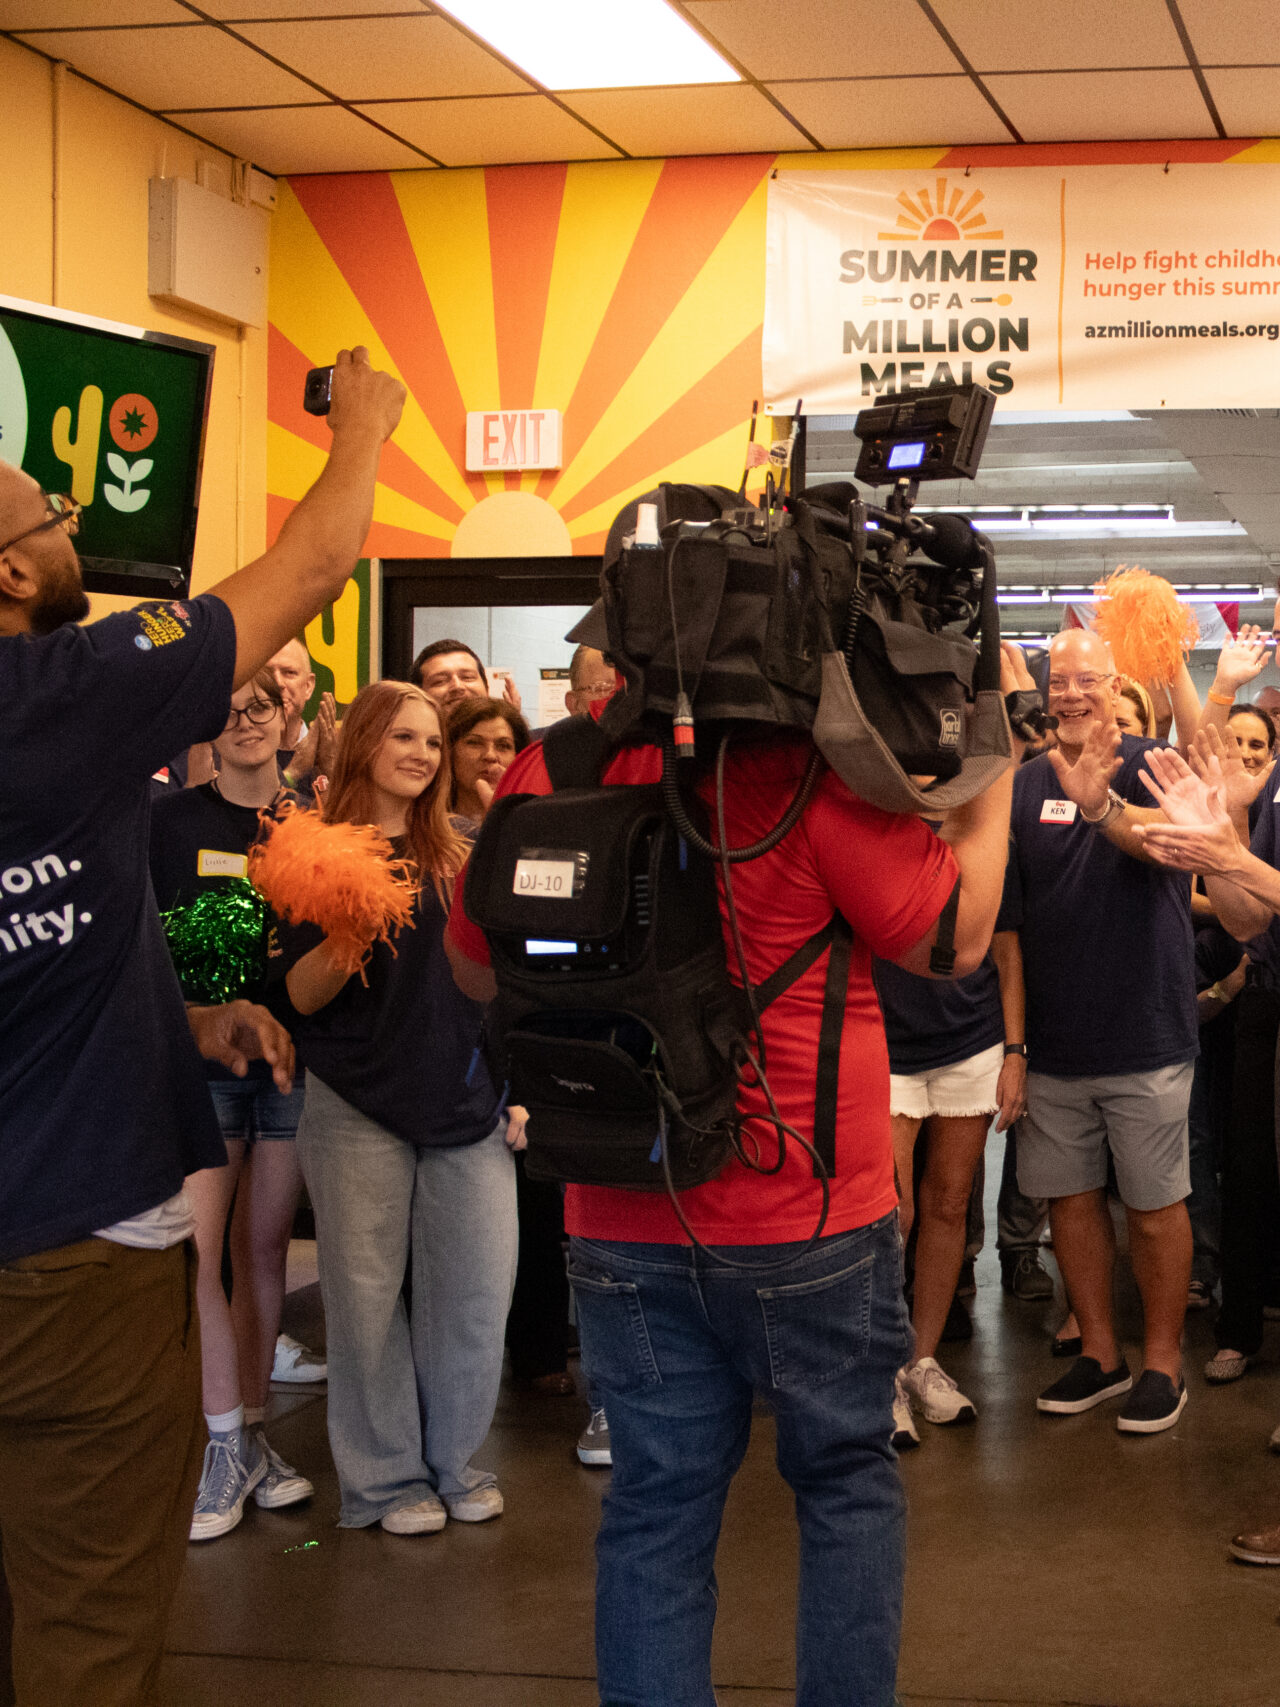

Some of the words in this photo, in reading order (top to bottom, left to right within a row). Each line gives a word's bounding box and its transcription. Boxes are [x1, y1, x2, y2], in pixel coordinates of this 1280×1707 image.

[839, 249, 1038, 284] SUMMER
[1085, 252, 1137, 274] Help
[1144, 250, 1198, 273] fight
[1083, 279, 1166, 301] hunger
[1173, 276, 1215, 296] this
[909, 293, 940, 310] OF
[946, 293, 963, 310] A
[842, 317, 1029, 354] MILLION
[1085, 320, 1279, 341] azmillionmeals.org
[482, 413, 545, 466] EXIT
[0, 854, 82, 899] on.
[520, 874, 563, 892] DJ-10
